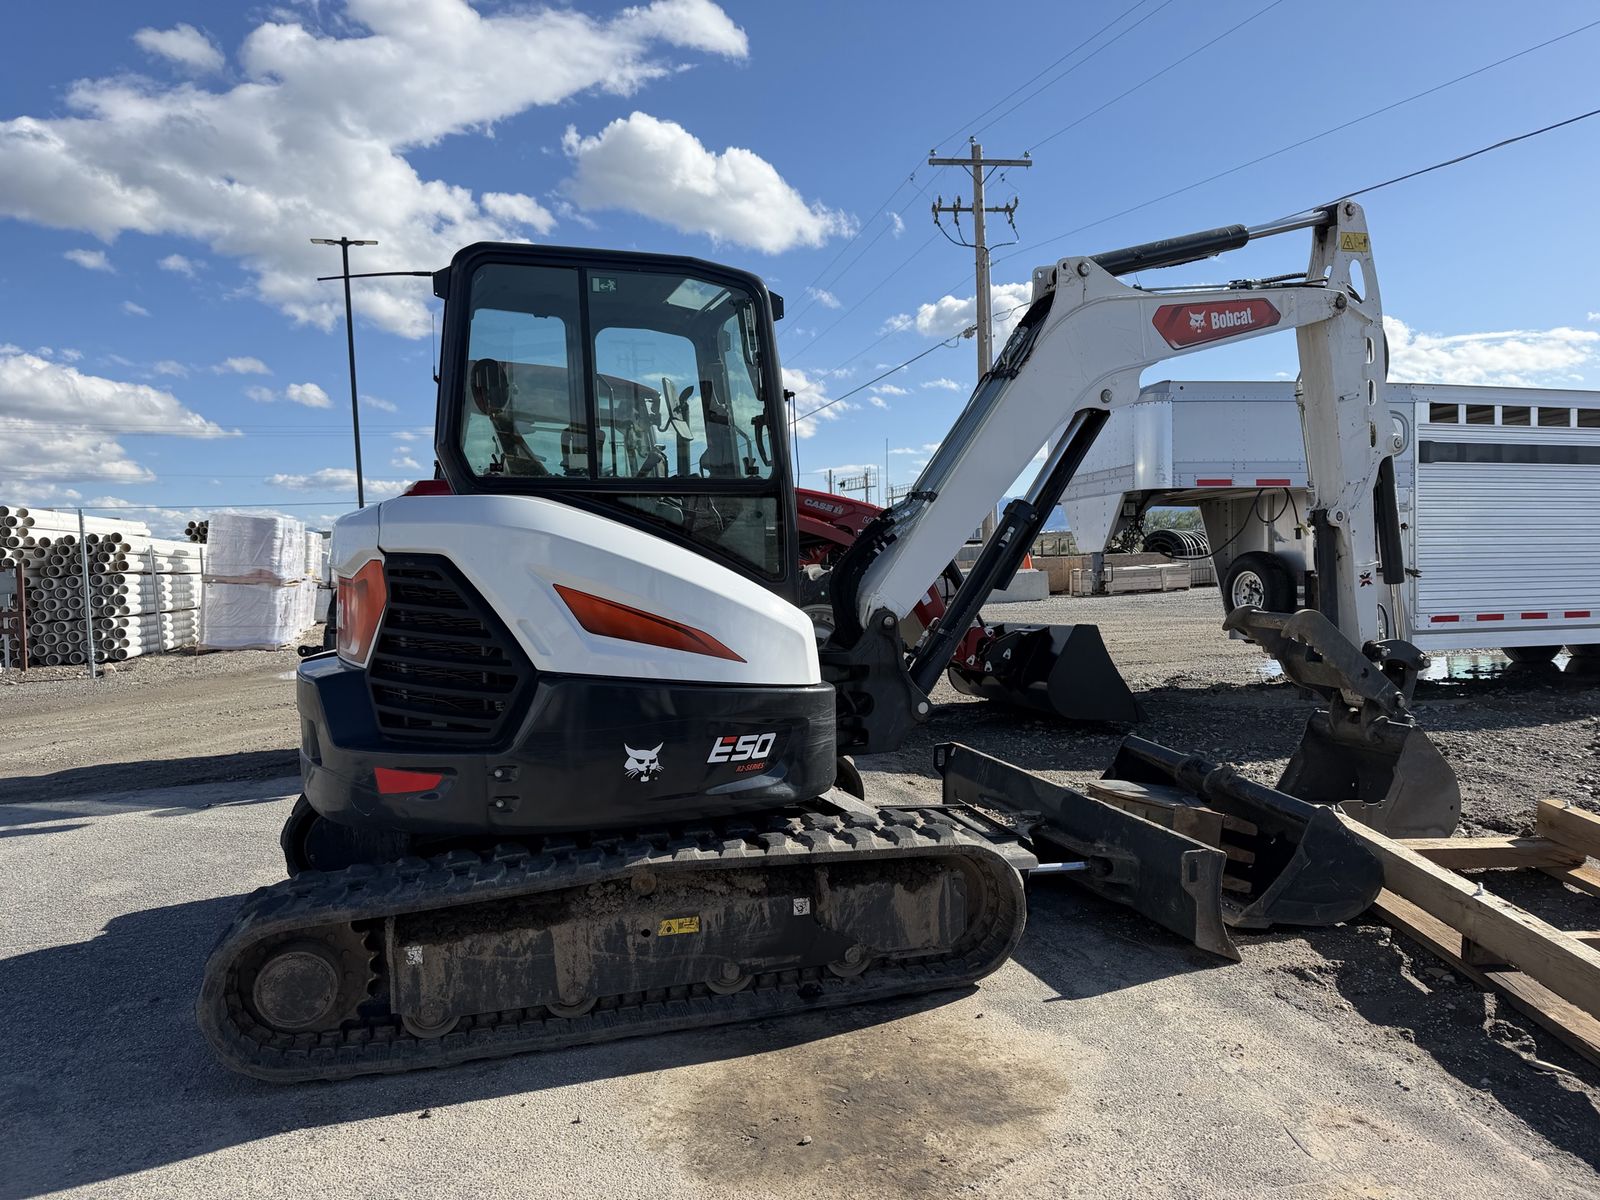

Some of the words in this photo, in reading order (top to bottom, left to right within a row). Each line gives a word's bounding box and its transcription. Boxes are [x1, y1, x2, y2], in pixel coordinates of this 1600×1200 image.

[1210, 307, 1252, 330] Bobcat
[804, 498, 833, 512] CASE
[706, 732, 777, 764] E50
